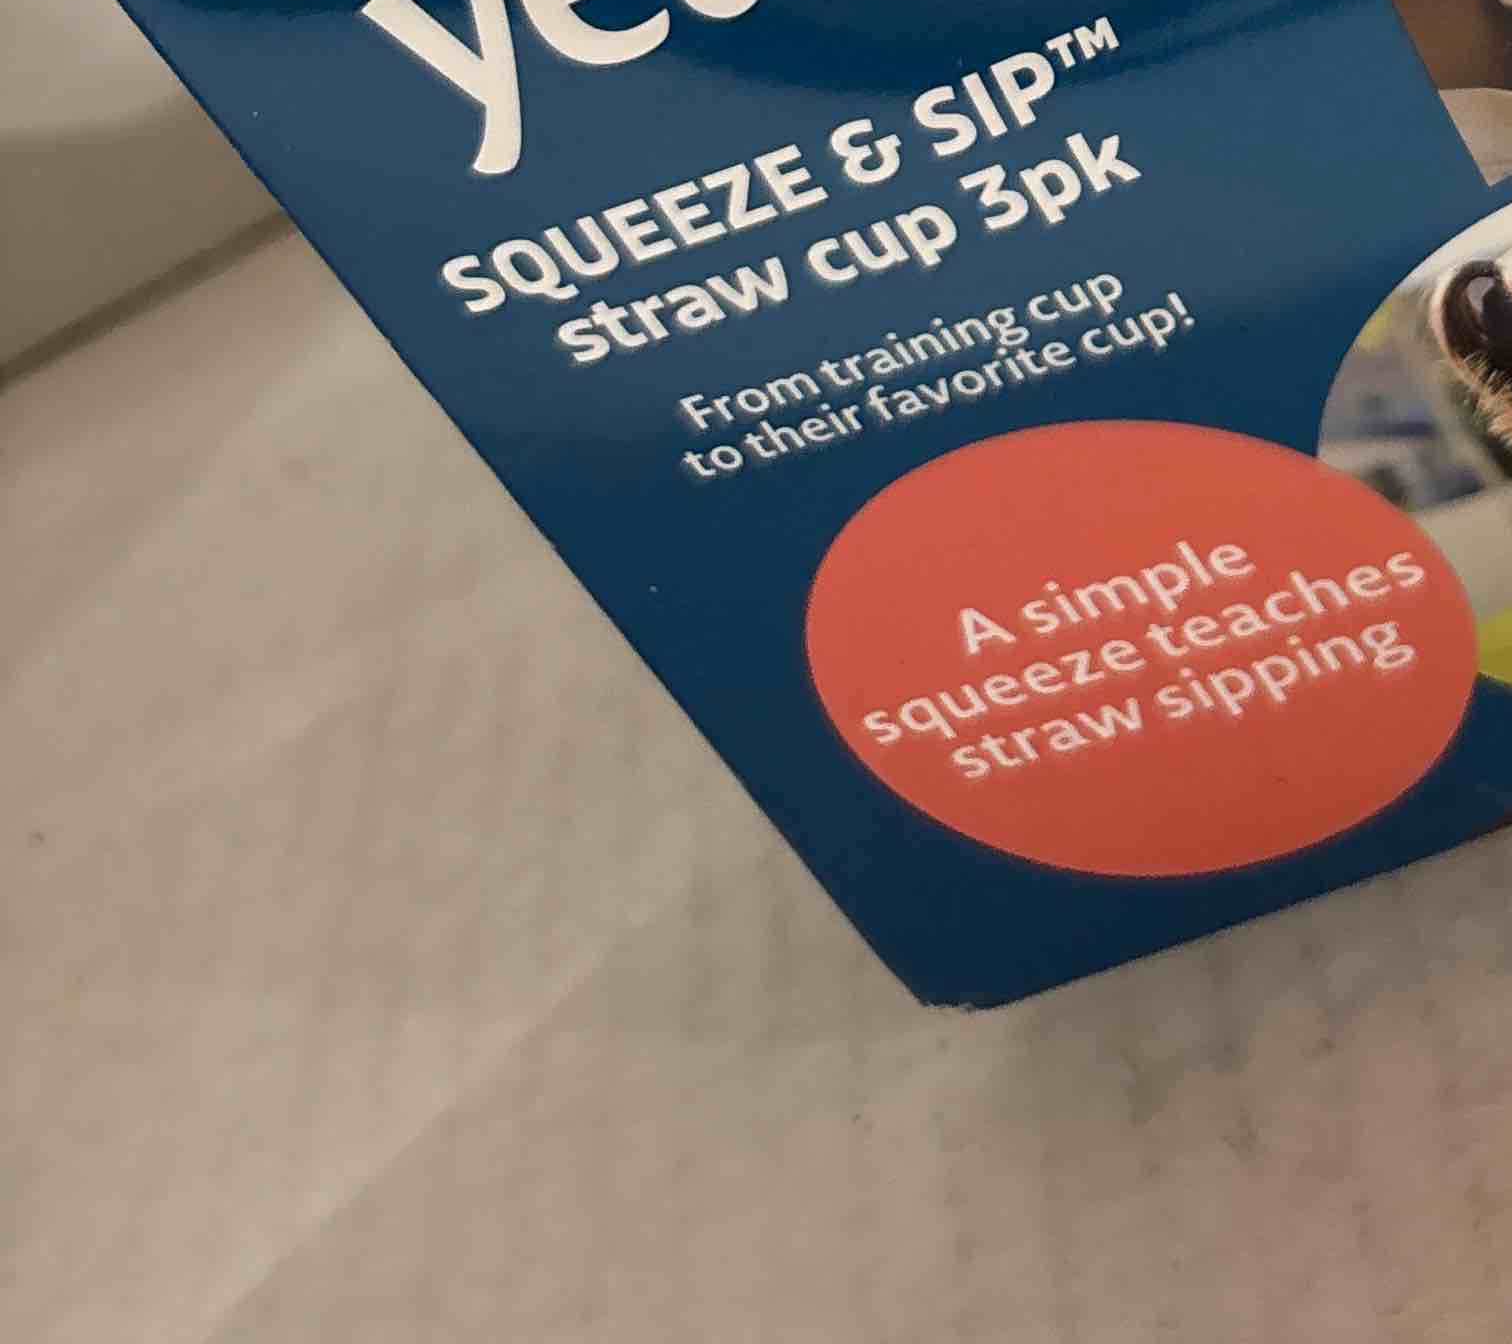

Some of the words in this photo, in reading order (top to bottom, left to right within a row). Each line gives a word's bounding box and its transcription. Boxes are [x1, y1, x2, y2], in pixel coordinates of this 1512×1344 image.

[440, 143, 829, 314] SQUEEZE
[830, 118, 902, 185] &
[556, 256, 791, 364] straw
[805, 201, 959, 284] cup
[958, 128, 1143, 233] 3pk
[678, 364, 820, 434] From
[819, 297, 1030, 386] training
[1026, 272, 1126, 326] cup
[680, 440, 745, 480] to
[743, 397, 868, 460] their
[867, 334, 1078, 431] favorite
[1080, 291, 1198, 358] cup!
[862, 635, 1147, 745] squeeze
[1144, 550, 1426, 660] teaches
[957, 607, 1016, 656] A
[1021, 539, 1257, 636] simple
[949, 695, 1144, 780] straw
[1152, 617, 1417, 724] sipping
